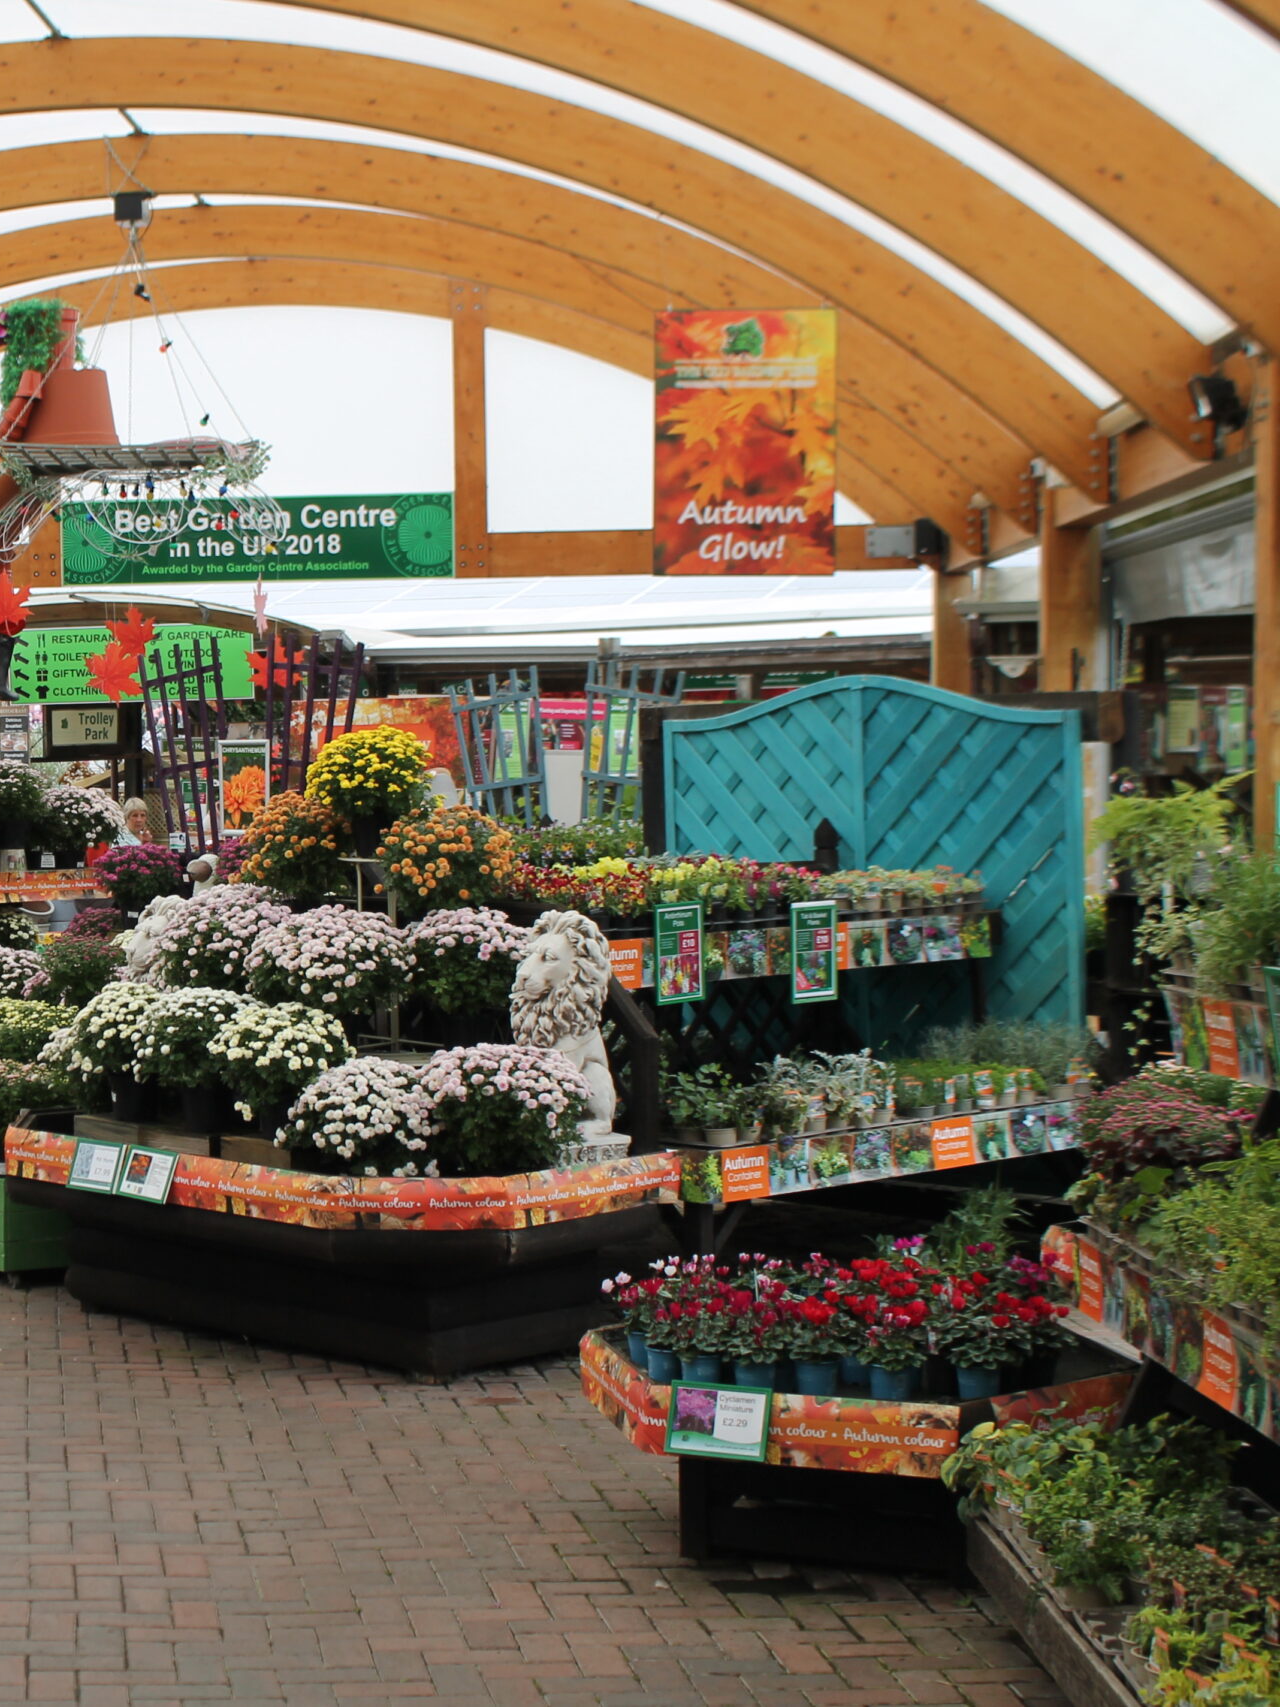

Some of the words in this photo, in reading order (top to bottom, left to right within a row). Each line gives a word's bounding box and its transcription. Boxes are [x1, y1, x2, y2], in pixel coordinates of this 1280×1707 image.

[115, 508, 178, 533] Best
[187, 505, 291, 532] Garden
[300, 503, 397, 529] Centre
[677, 500, 807, 526] Autumn
[169, 538, 190, 558] in
[197, 536, 236, 557] the
[242, 535, 278, 556] UK
[285, 534, 341, 555] 2018
[699, 532, 786, 563] Glow!
[141, 564, 189, 576] Awarded
[190, 564, 204, 577] by
[205, 563, 223, 574] the
[226, 562, 265, 574] Garden
[268, 561, 303, 572] Centre
[305, 560, 369, 572] Association
[52, 634, 115, 644] RESTAURAN
[167, 631, 213, 640] GARDEN
[216, 630, 246, 639] CARE
[53, 669, 96, 678] GIFTWA
[79, 712, 114, 728] Trolley
[84, 728, 109, 740] Park
[681, 938, 695, 948] £10
[933, 1126, 969, 1141] Autumn
[936, 1139, 968, 1151] Container
[12, 1148, 36, 1160] Autumn
[37, 1150, 55, 1162] colour
[724, 1153, 765, 1172] Autumn
[727, 1170, 762, 1182] Container
[190, 1175, 211, 1190] colour
[217, 1180, 245, 1195] Autumn
[246, 1184, 267, 1198] colour
[275, 1188, 305, 1204] Autumn
[306, 1194, 328, 1208] colour
[339, 1196, 381, 1209] Autumn
[383, 1196, 415, 1209] colour
[429, 1197, 472, 1209] Autumn
[475, 1196, 507, 1208] colour
[516, 1192, 547, 1206] Autumn
[548, 1189, 569, 1202] colour
[577, 1182, 606, 1197] Autumn
[607, 1179, 629, 1193] colour
[635, 1175, 662, 1188] Autumn
[719, 1394, 756, 1406] Cyclamen
[720, 1403, 754, 1414] Miniature
[722, 1417, 748, 1428] £2.29
[787, 1423, 827, 1439] colour
[843, 1427, 902, 1446] Autumn
[904, 1432, 946, 1449] colour
